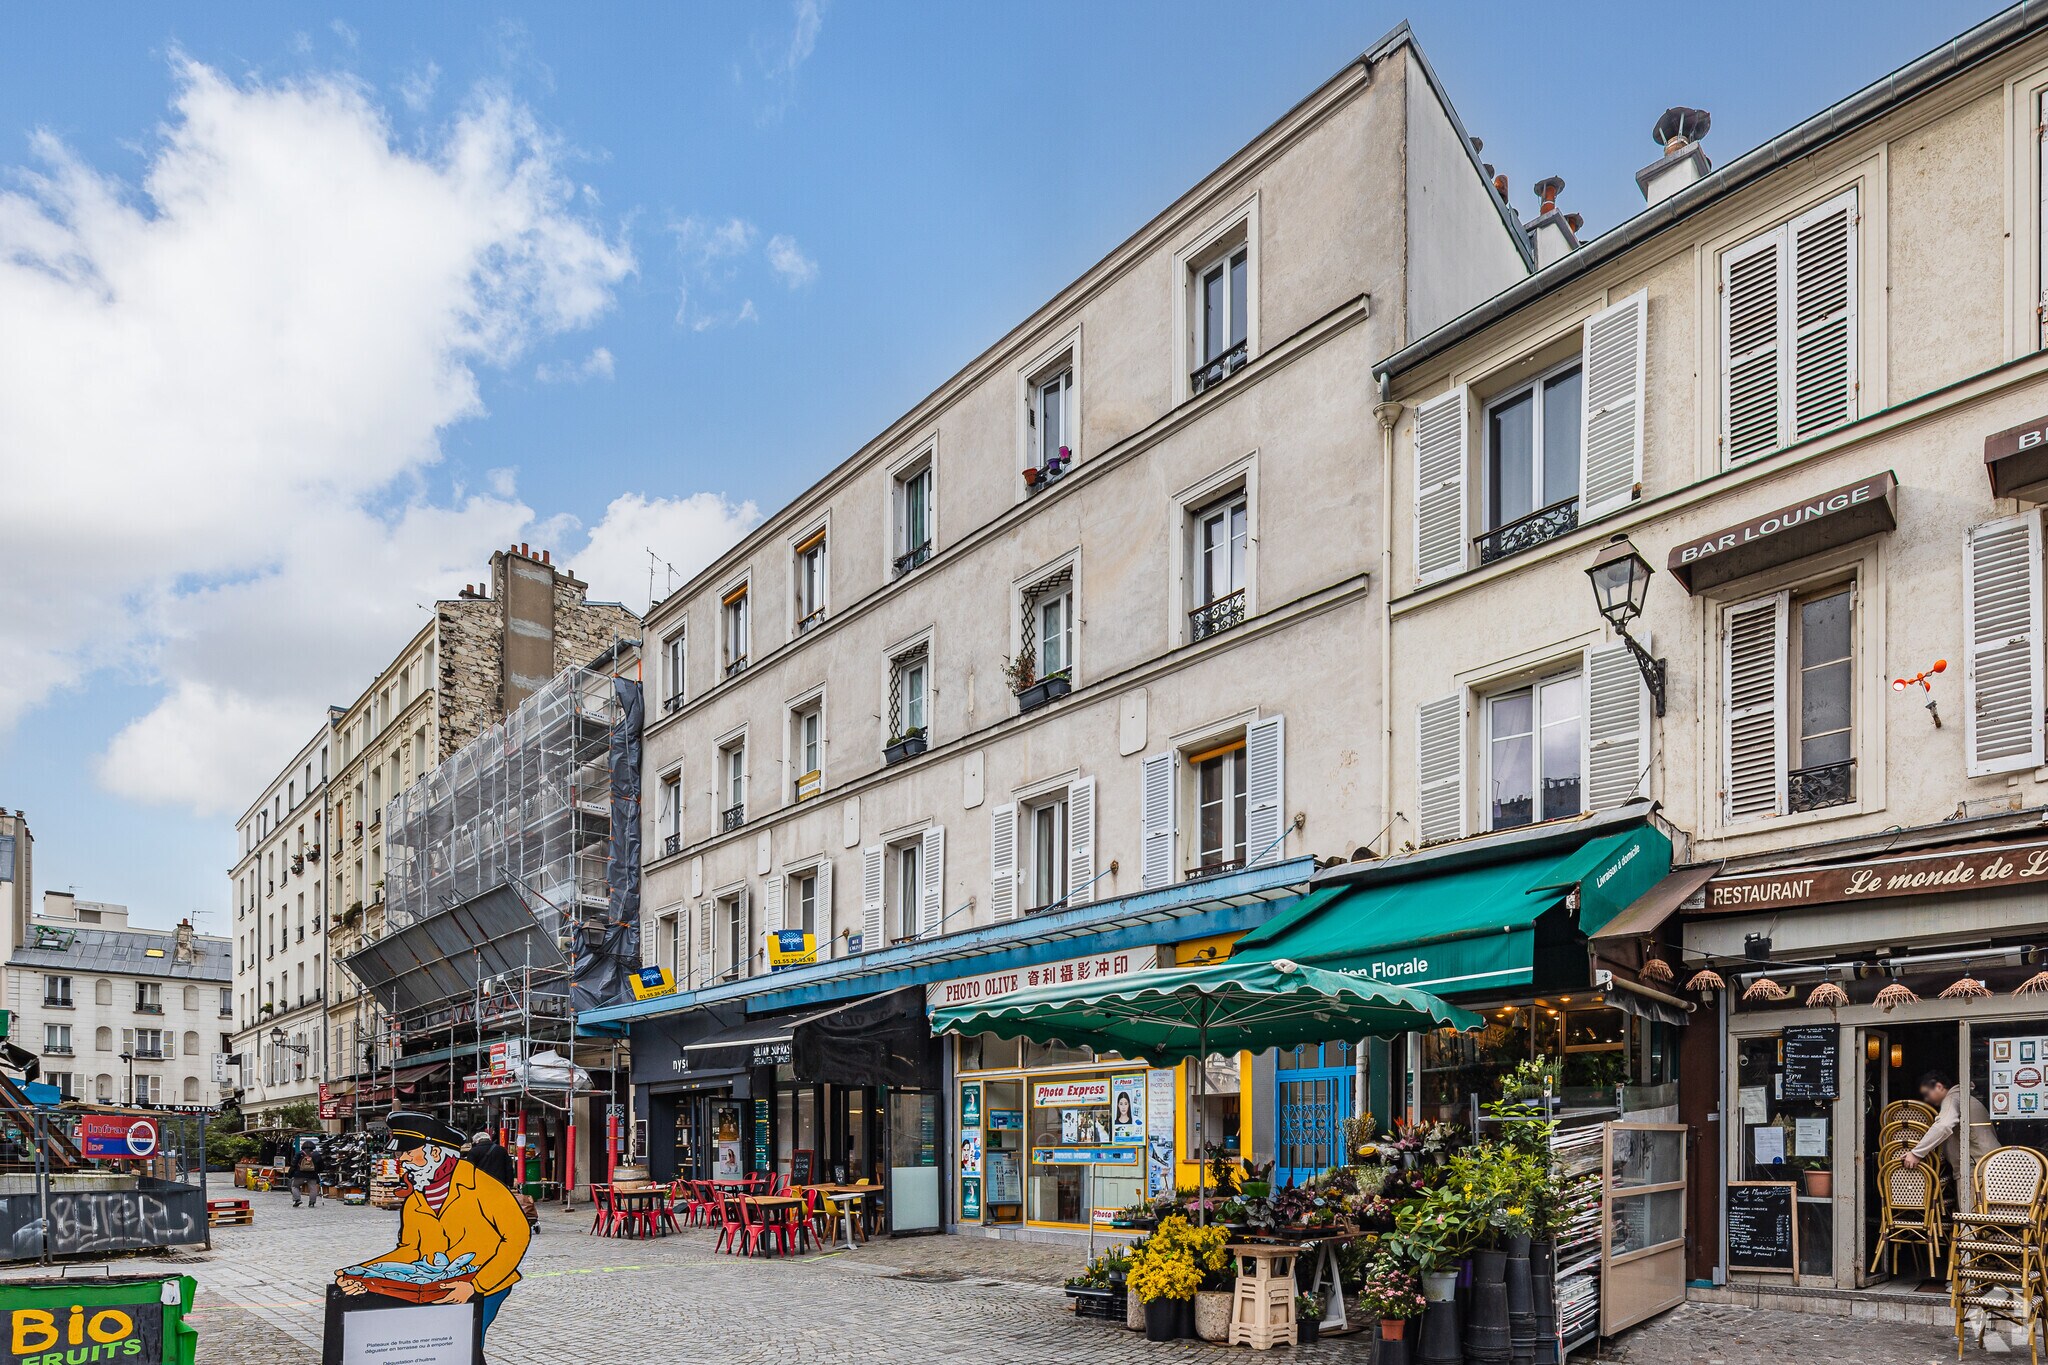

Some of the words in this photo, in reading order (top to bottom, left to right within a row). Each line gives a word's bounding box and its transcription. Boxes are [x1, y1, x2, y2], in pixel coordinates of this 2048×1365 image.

[2018, 427, 2048, 450] B
[1681, 533, 1736, 563] BAR
[1744, 485, 1870, 541] LOUNGE
[1596, 864, 1618, 888] Livraison
[1621, 844, 1640, 866] domicile
[1844, 869, 1882, 895] Le
[1886, 861, 1975, 890] monde
[1980, 856, 2014, 880] de
[1713, 880, 1814, 906] RESTAURANT
[1372, 957, 1428, 978] Florale
[946, 980, 980, 1002] PHOTO
[985, 974, 1018, 996] OLIVE
[1038, 1087, 1064, 1097] Photo
[1067, 1085, 1105, 1097] Express
[22, 1338, 142, 1365] FRUITS
